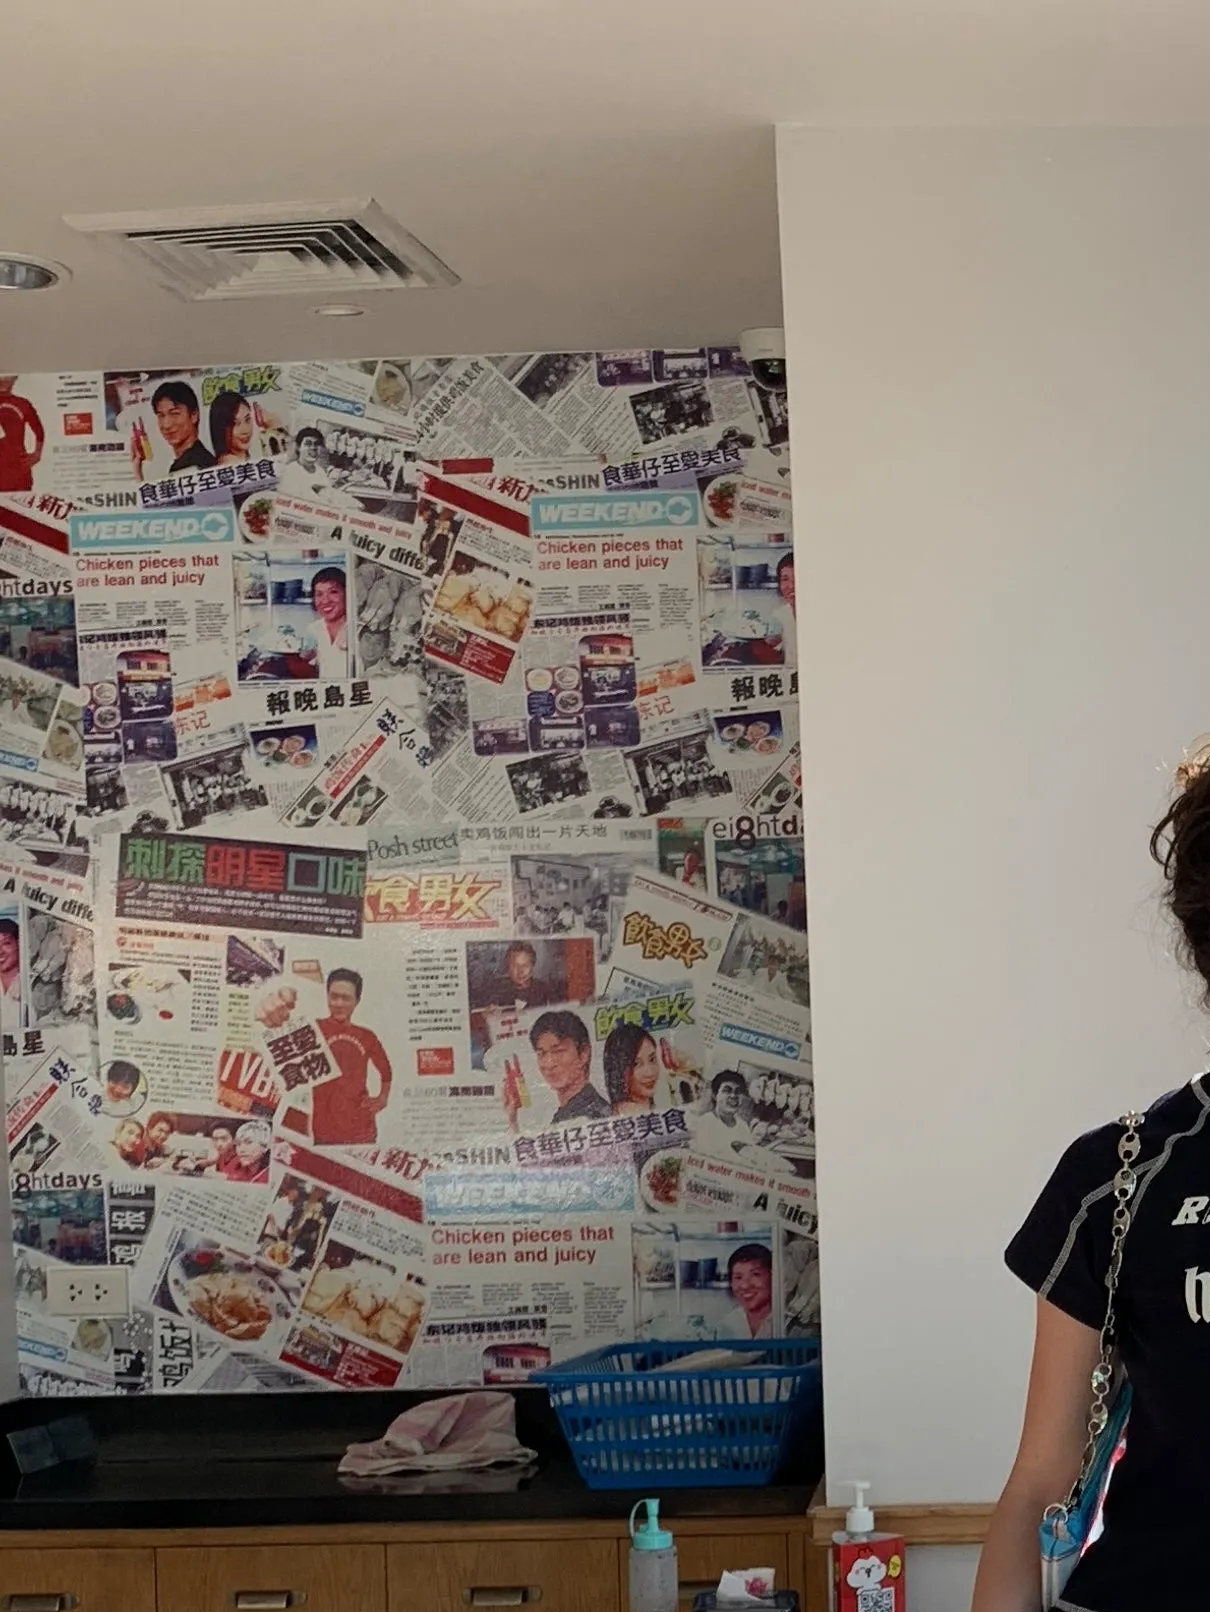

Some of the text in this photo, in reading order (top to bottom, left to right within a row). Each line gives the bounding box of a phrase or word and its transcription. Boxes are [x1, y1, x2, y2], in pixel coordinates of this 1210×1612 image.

[603, 447, 742, 489] 食華仔至愛美食
[139, 459, 277, 504] 食華仔至愛美食
[539, 499, 663, 526] WEEKEND
[77, 516, 200, 542] WEEKEND
[331, 526, 342, 541] A
[537, 537, 683, 556] Chicken pieces that
[76, 554, 219, 572] Chicken pieces that
[538, 553, 670, 572] are lean and juicy
[0, 578, 73, 596] htdays
[76, 571, 206, 589] are lean and juicy
[367, 831, 458, 862] Posh street
[125, 837, 366, 897] 刺探明星口味
[3, 875, 17, 894] A
[514, 1108, 689, 1161] 食華仔至愛美食
[752, 1190, 770, 1211] A
[1172, 1196, 1208, 1225] R
[432, 1225, 614, 1247] Chicken pieces that
[432, 1246, 597, 1267] are lean and juicy
